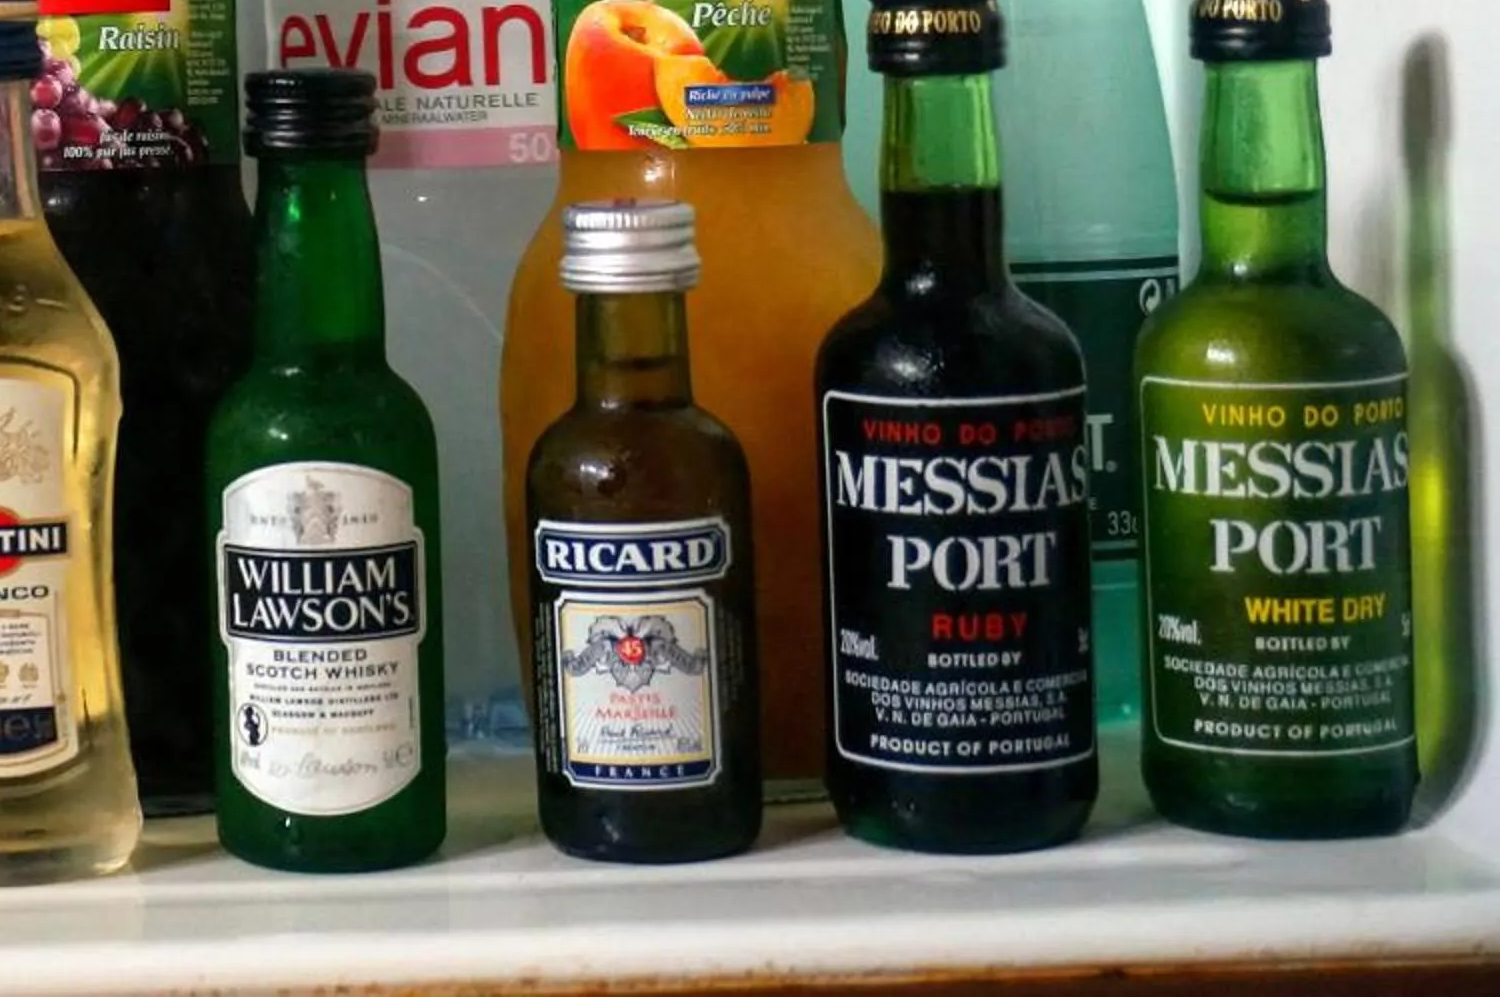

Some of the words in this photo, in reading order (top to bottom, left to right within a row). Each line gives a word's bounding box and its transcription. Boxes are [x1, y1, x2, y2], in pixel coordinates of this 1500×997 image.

[921, 9, 981, 35] PORTO
[99, 25, 181, 52] Raisin
[416, 92, 540, 111] NATURELLE
[508, 131, 552, 163] 50
[1202, 403, 1286, 429] VINHO
[1303, 404, 1339, 428] DO
[1353, 396, 1404, 424] PORTO
[862, 419, 943, 446] VINHO
[958, 421, 997, 446] DO
[1152, 433, 1408, 499] MESSIAS
[835, 445, 1087, 515] MESSIAS
[545, 536, 717, 573] RICARD
[1208, 516, 1383, 575] PORT
[886, 532, 1058, 592] PORT
[237, 557, 397, 595] WILLIAM
[232, 590, 410, 633] LAWSON'S
[1244, 595, 1336, 625] WHITE
[1341, 593, 1387, 621] DRY
[931, 611, 1028, 643] RUBY
[273, 647, 368, 664] BLENDED
[1255, 635, 1328, 652] BOTTLED
[1330, 634, 1353, 651] BY
[245, 663, 319, 681] SCOTCH
[323, 661, 400, 680] WHISKY
[927, 651, 1000, 669] BOTTLED
[1001, 650, 1023, 667] BY
[1163, 654, 1250, 679] SOCIEDADE
[1252, 659, 1340, 680] AGRÍCOLA
[1342, 664, 1352, 678] E
[845, 669, 921, 696] SOCIEDADE
[924, 676, 1011, 697] AGRÍCOLA
[1013, 680, 1024, 694] E
[1193, 676, 1228, 693] DOS
[1230, 678, 1298, 695] VINHOS
[871, 690, 902, 709] DOS
[904, 694, 966, 713] VINHOS
[1198, 692, 1215, 708] V.
[1217, 692, 1235, 709] N.
[1238, 694, 1262, 710] DE
[1264, 694, 1308, 711] GAIA
[1319, 689, 1392, 710] PORTUGAL
[874, 705, 890, 723] V.
[891, 709, 908, 726] N.
[911, 711, 934, 727] DE
[936, 711, 977, 729] GAIA
[989, 705, 1066, 726] PORTUGAL
[1193, 718, 1281, 741] PRODUCT
[1286, 724, 1314, 740] OF
[1318, 717, 1398, 740] PORTUGAL
[869, 733, 953, 757] PRODUCT
[956, 740, 982, 756] OF
[987, 732, 1071, 755] PORTUGAL
[594, 765, 686, 779] FRANCE
